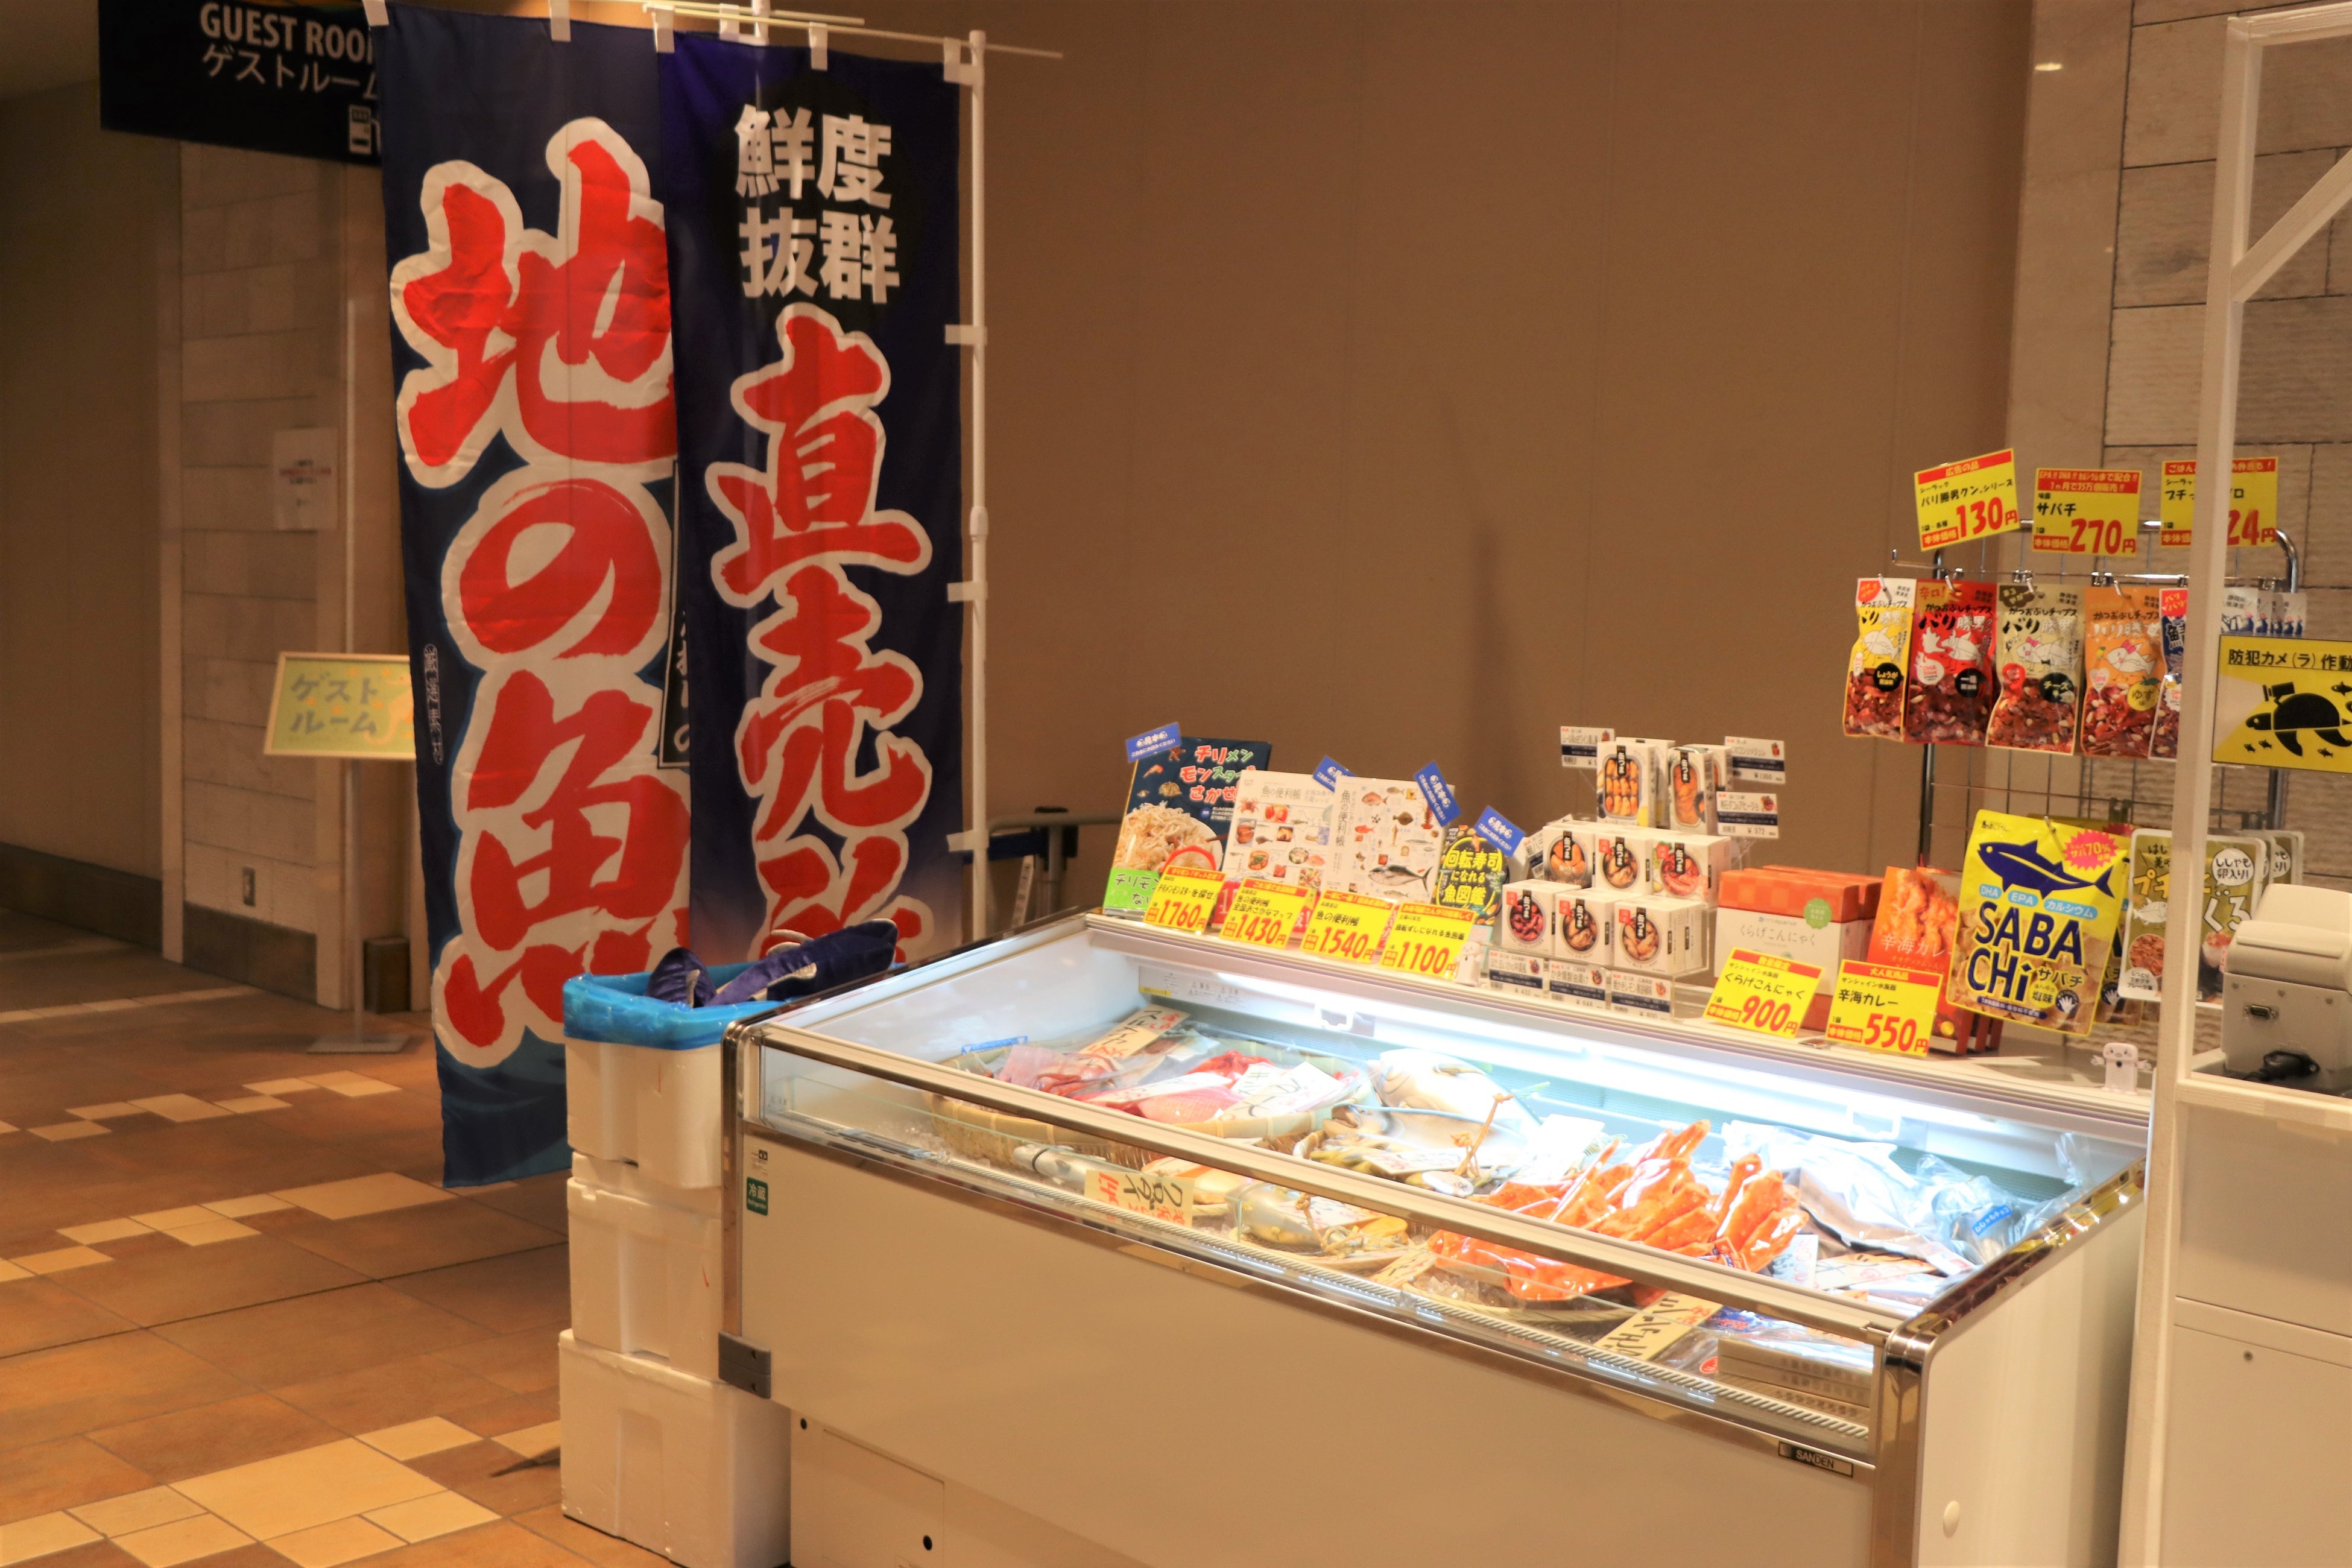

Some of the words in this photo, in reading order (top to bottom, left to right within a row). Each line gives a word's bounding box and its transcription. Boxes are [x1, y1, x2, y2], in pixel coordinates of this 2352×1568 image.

[200, 2, 298, 51] GUEST
[735, 104, 892, 209] 鮮度
[739, 207, 900, 305] 抜群
[2168, 464, 2196, 473] ごはん
[1956, 496, 2018, 538] 130円
[2037, 502, 2076, 517] サバチ
[2070, 517, 2136, 554] 270円
[390, 118, 692, 1066] 地の魚
[291, 669, 378, 705] ゲスト
[2131, 689, 2154, 699] ゆず
[290, 708, 378, 736] ルーム
[1195, 744, 1254, 765] チリメン
[1262, 786, 1301, 800] 魚の便利帳
[1335, 789, 1351, 847] 魚の便利帳
[1446, 849, 1502, 871] 回転寿司
[2216, 857, 2251, 868] ししゃも
[1450, 868, 1487, 884] になれる
[2217, 867, 2250, 880] 卵入り!
[1443, 885, 1488, 906] 魚図鑑
[1981, 885, 1999, 898] DHA
[2011, 892, 2034, 905] EPA
[1232, 903, 1294, 920] 全国おさかなマップ
[1317, 909, 1361, 927] 魚の便利帳
[2047, 899, 2094, 918] カルシウム
[1738, 923, 1816, 947] くらげこんにゃく
[1974, 900, 2084, 967] SABA
[1728, 962, 1779, 979] サンシャイン水族館
[1870, 967, 1909, 981] 大人気商品
[2037, 966, 2083, 988] サバチ
[1724, 972, 1806, 1000] くらげこんにゃく
[1841, 976, 1897, 991] サンシャイン水族館
[1838, 989, 1898, 1007] 辛海カレー
[2032, 990, 2053, 1004] 塩味
[1742, 995, 1798, 1035] 900円
[1864, 1013, 1929, 1053] 550円
[748, 1183, 767, 1201] 冷蔵
[1796, 1449, 1835, 1469] SANDEN
